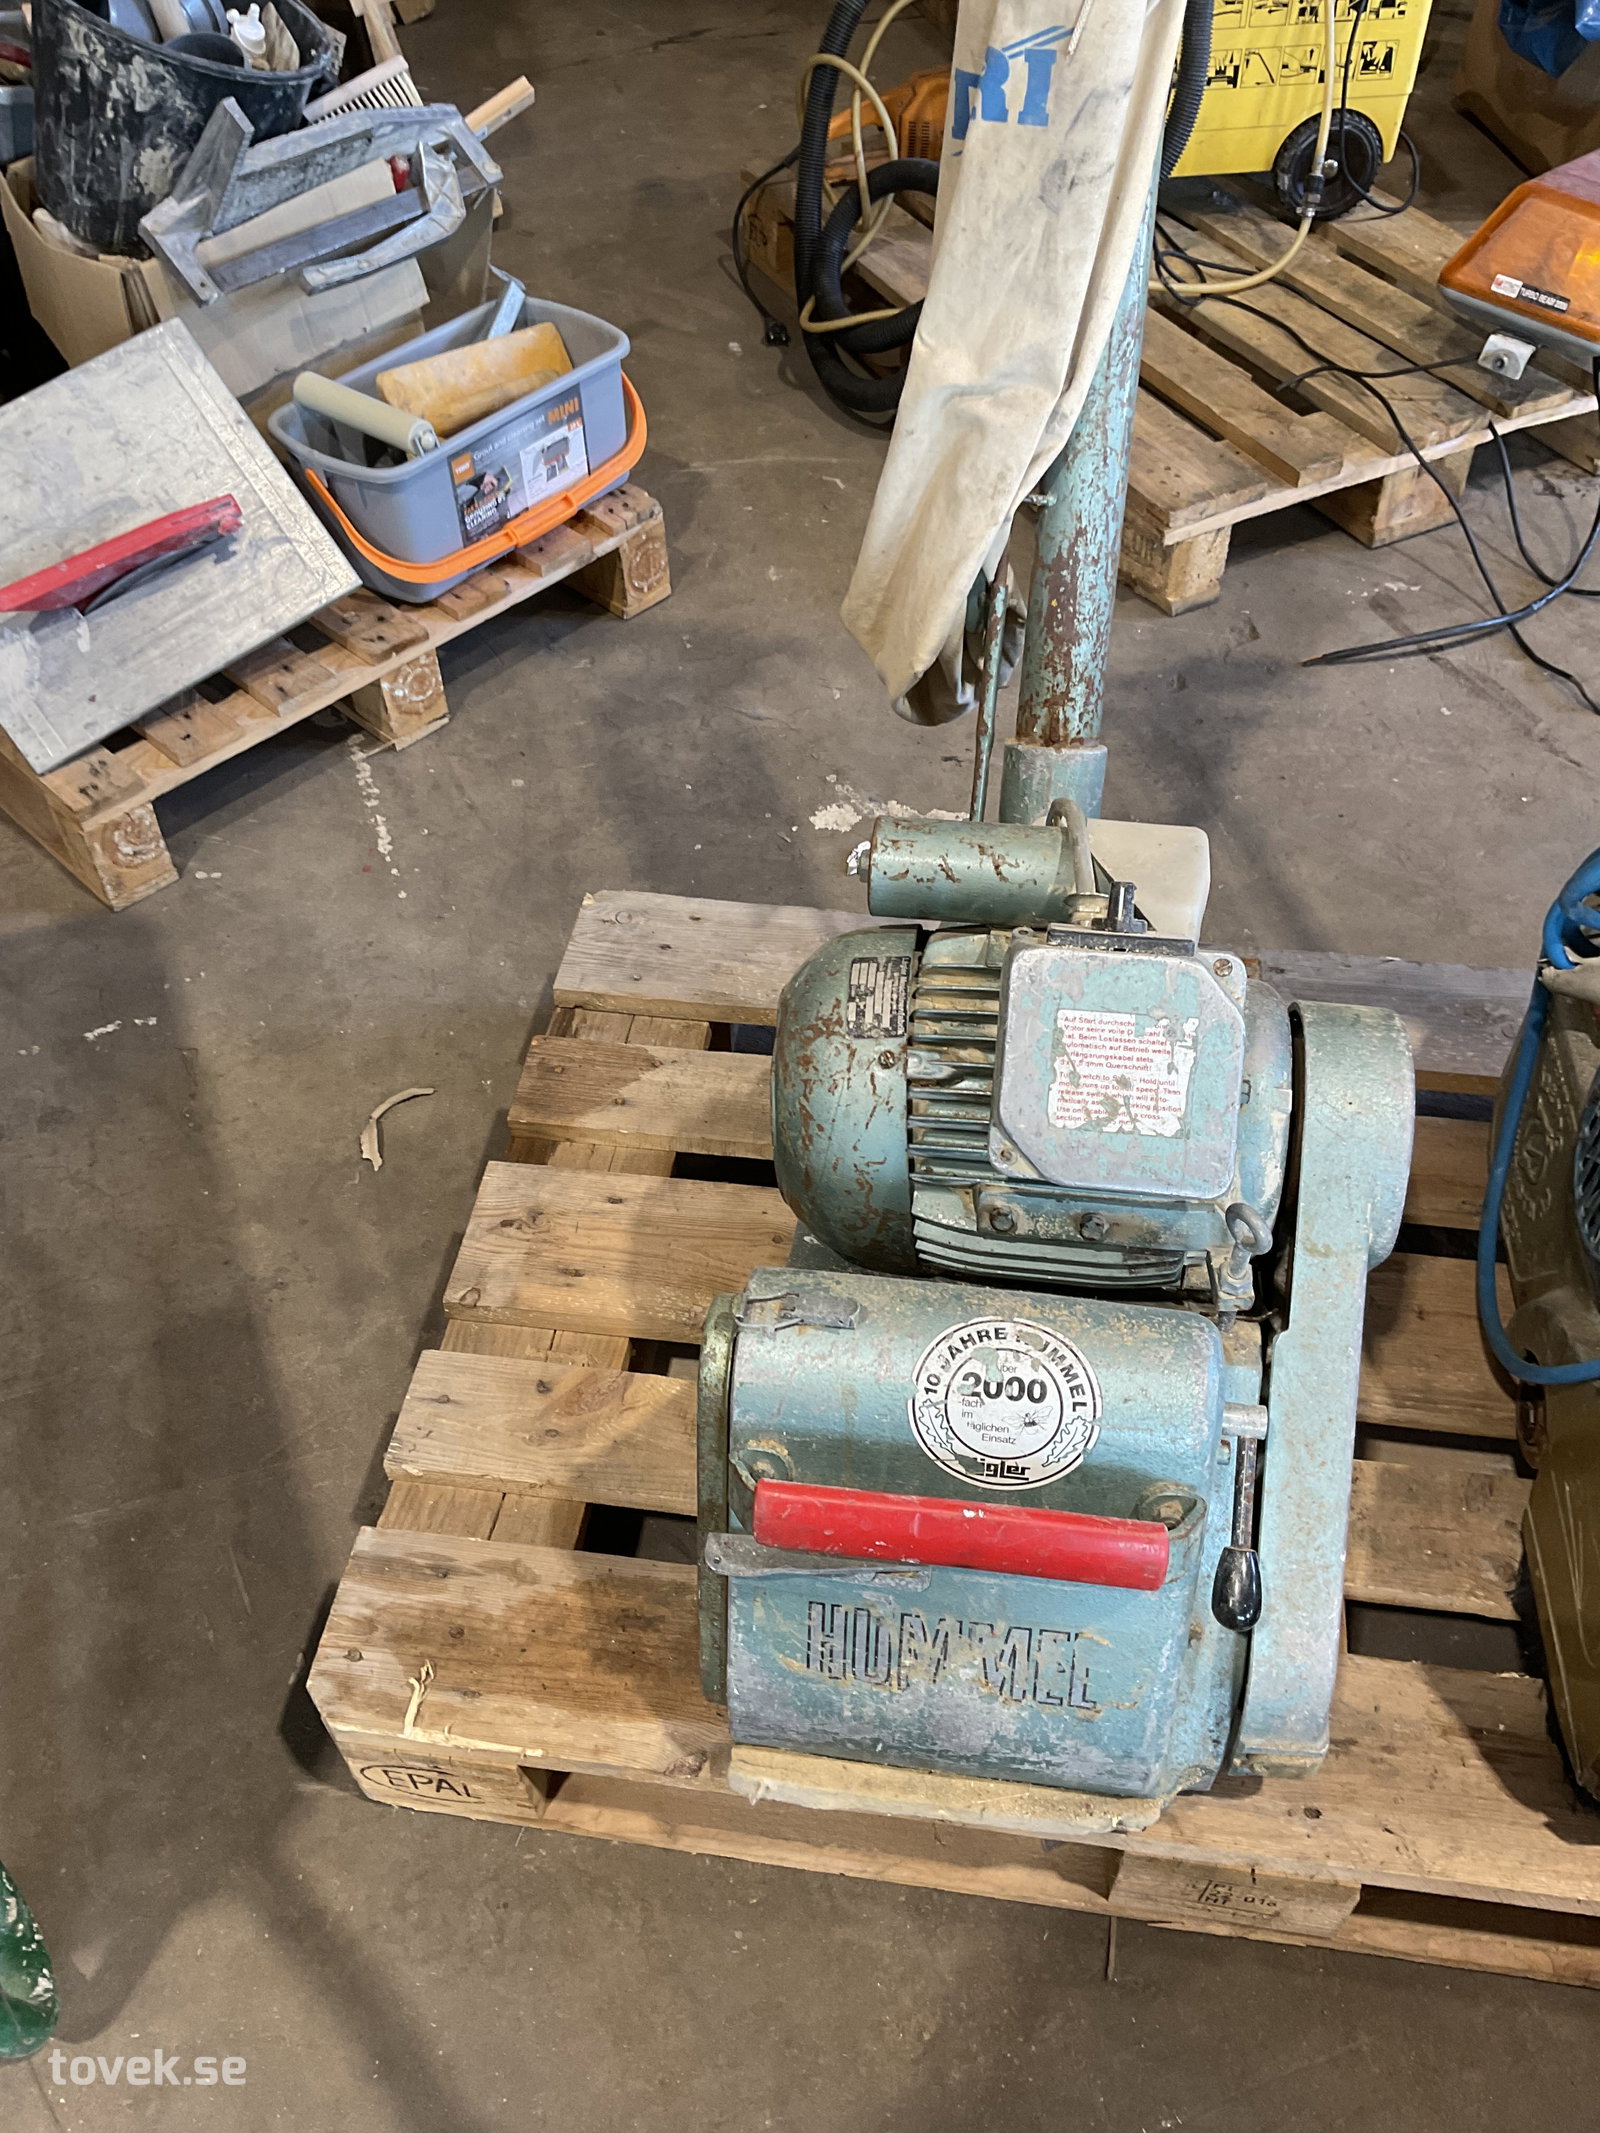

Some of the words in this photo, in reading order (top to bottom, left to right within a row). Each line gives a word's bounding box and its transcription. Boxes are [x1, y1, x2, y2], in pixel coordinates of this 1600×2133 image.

[547, 397, 580, 424] MINI
[1078, 1017, 1096, 1025] Start
[1099, 1036, 1136, 1044] Loslassen
[1123, 1046, 1150, 1054] Betrieb
[1139, 1077, 1157, 1085] Hold
[1136, 1094, 1148, 1102] will
[1056, 1114, 1082, 1122] section
[924, 1374, 942, 1395] 10
[940, 1327, 1008, 1370] JAHRE
[1000, 1364, 1018, 1374] ber
[960, 1372, 1048, 1404] 2000
[962, 1410, 974, 1419] im
[982, 1434, 1017, 1446] Einsatz
[806, 1601, 1097, 1709] HUMMEL
[382, 1769, 482, 1800] EPAL
